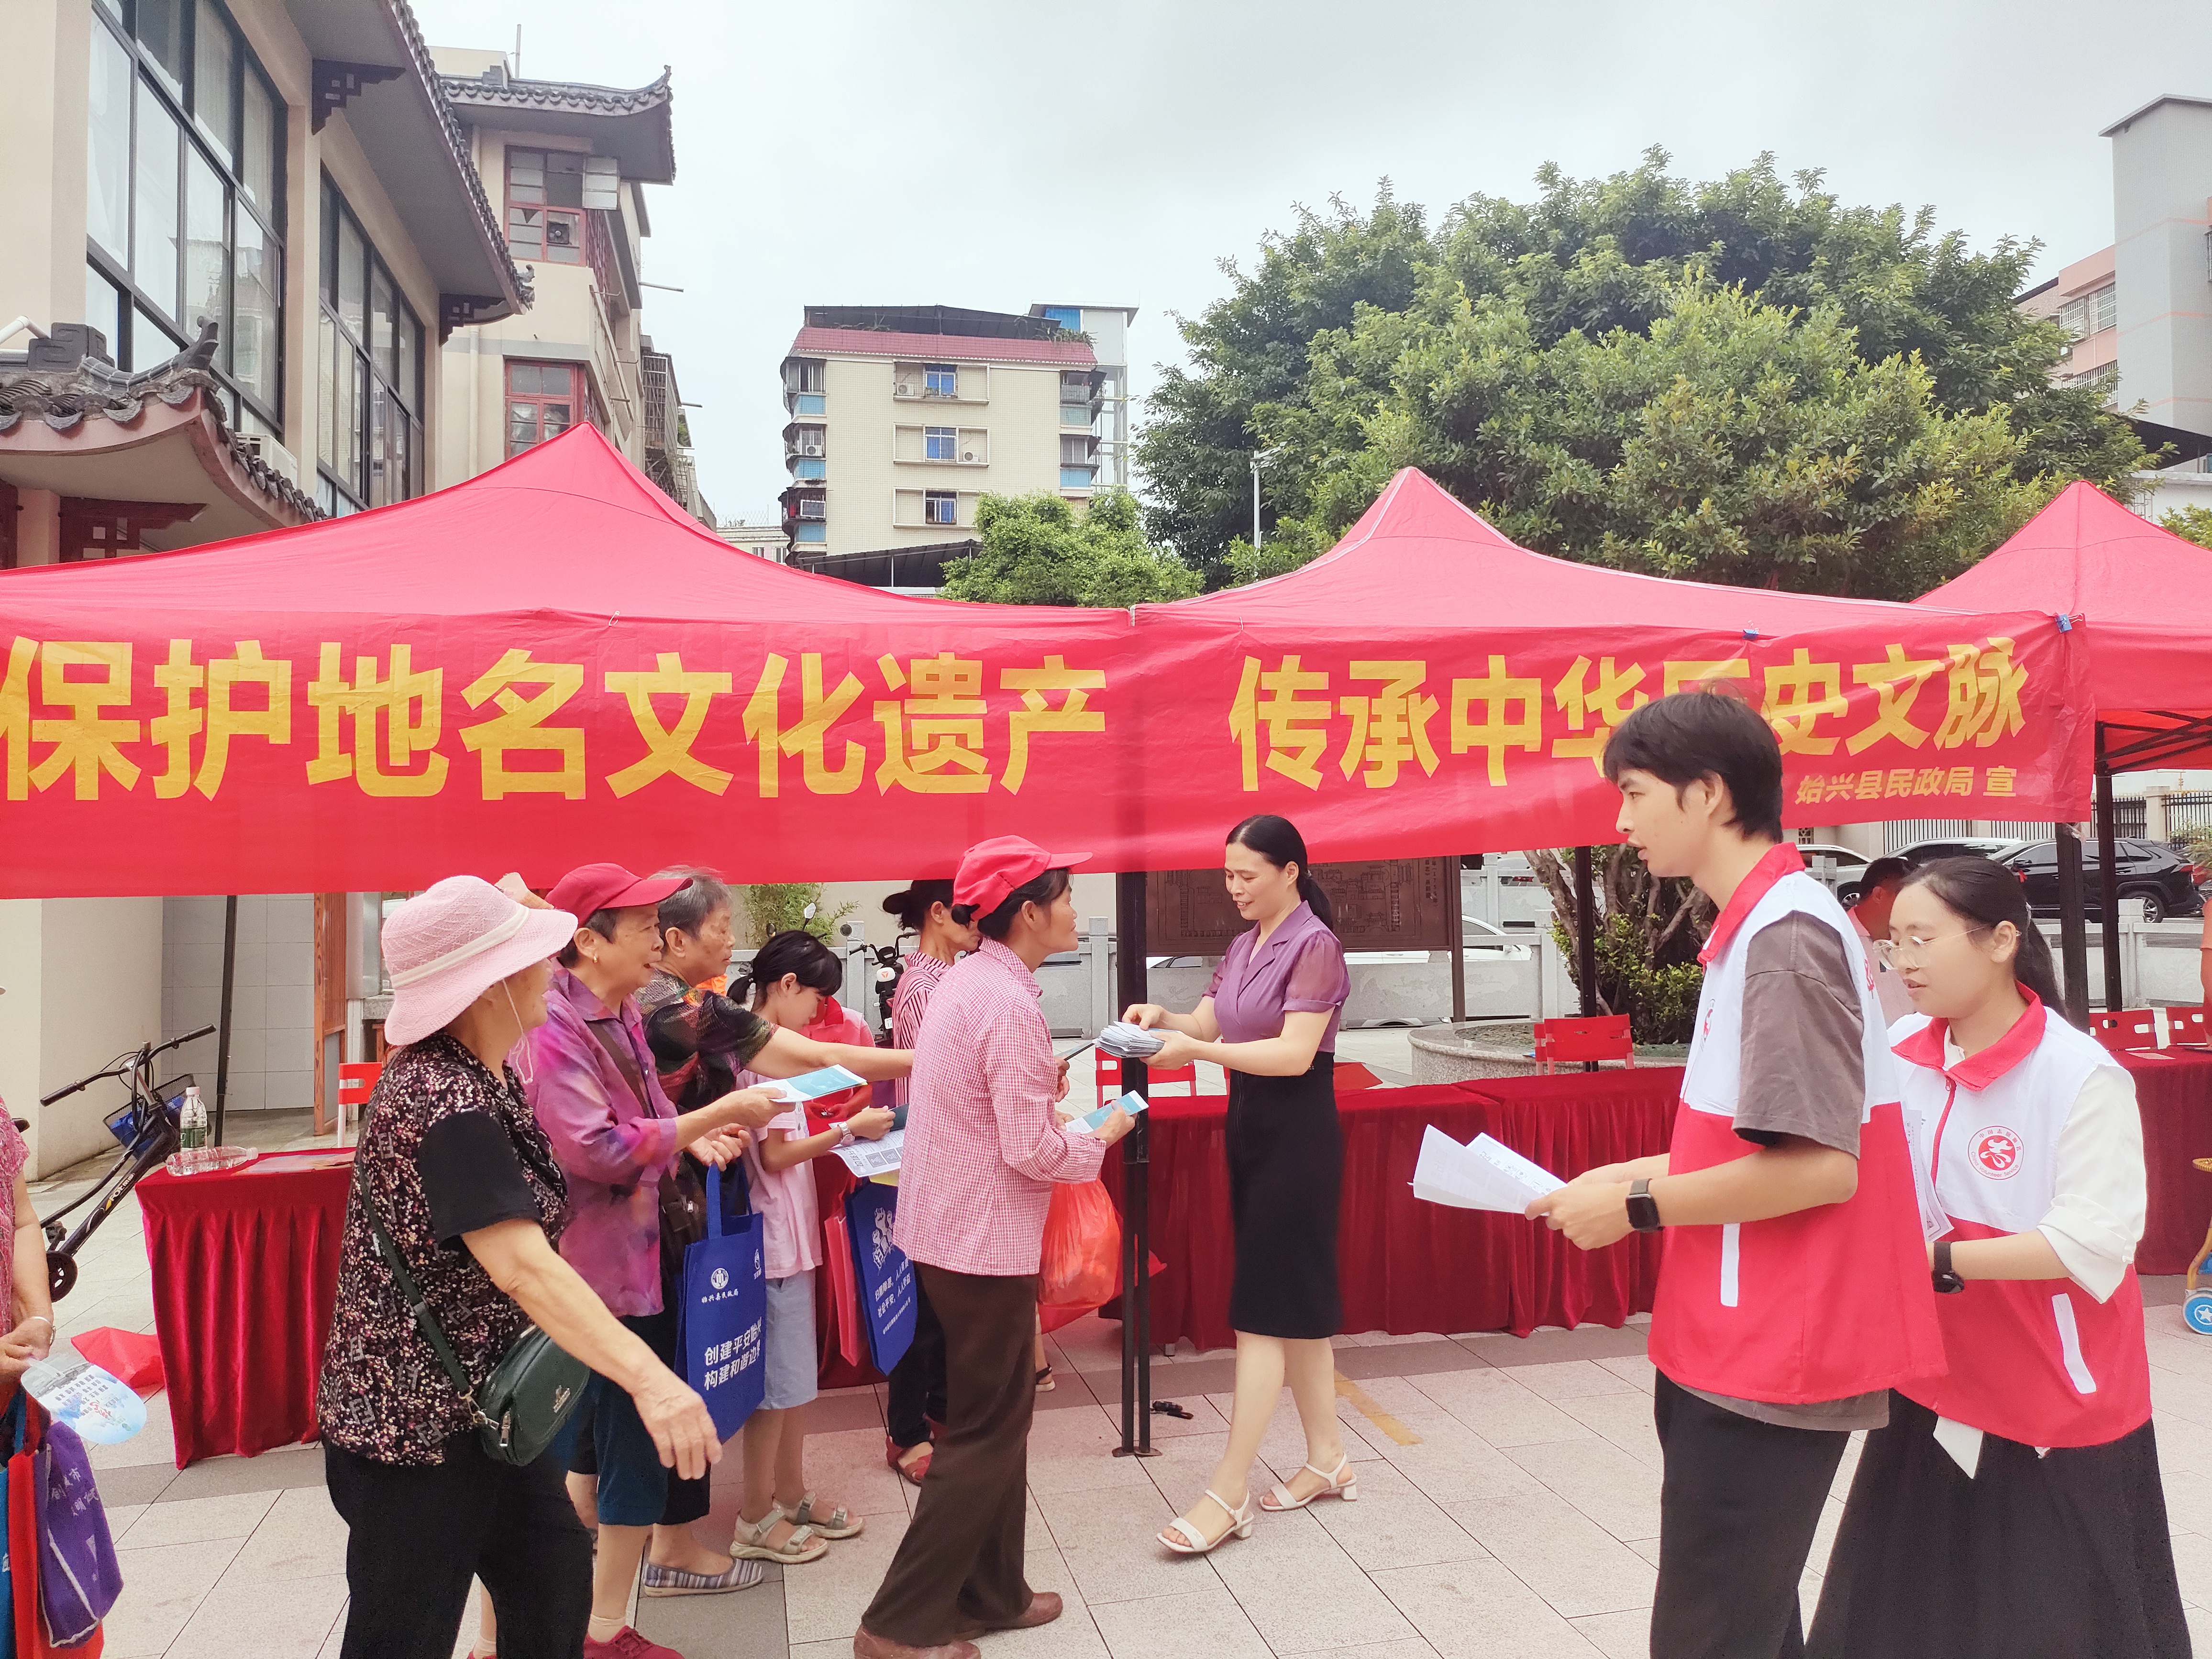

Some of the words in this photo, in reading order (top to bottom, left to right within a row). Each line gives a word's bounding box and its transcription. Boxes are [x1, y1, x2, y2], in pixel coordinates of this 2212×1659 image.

[0, 636, 1107, 801] 保护地名文化遗产
[1794, 766, 1972, 805] 始兴县民政局
[1982, 766, 2017, 797] 宣
[1971, 1151, 1979, 1166] China
[1980, 1166, 2002, 1177] Volunteer
[2003, 1164, 2019, 1176] Service
